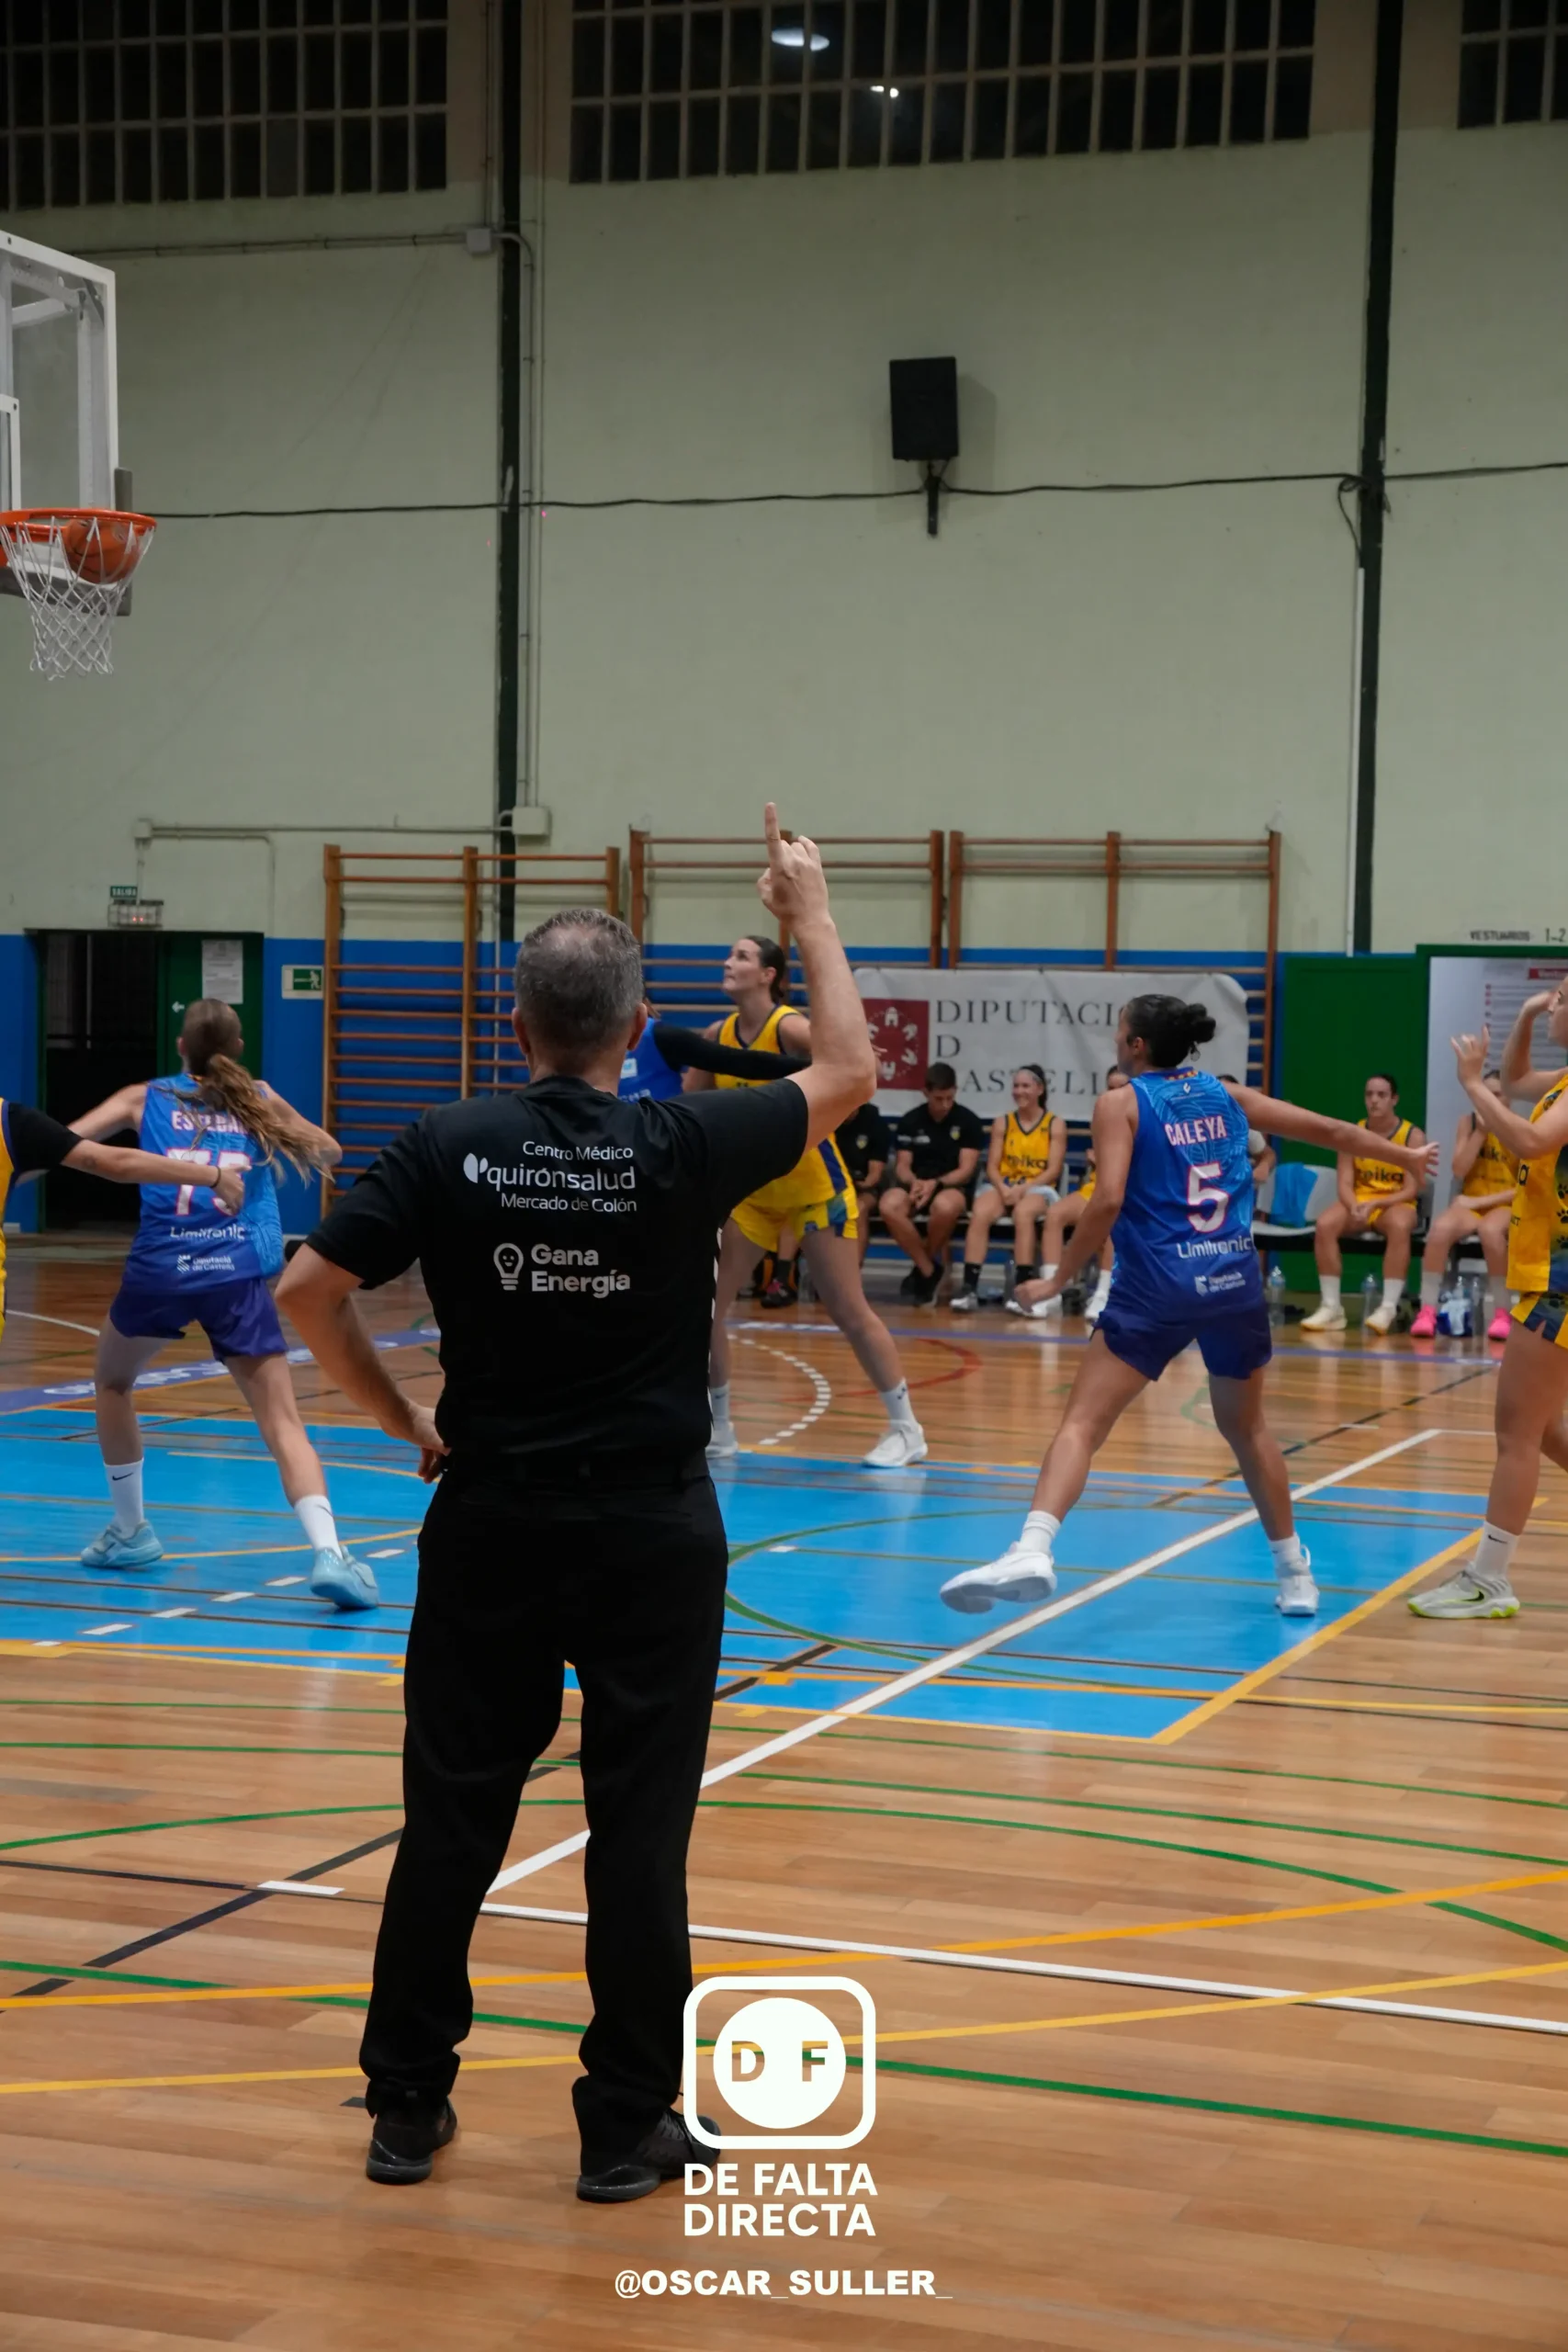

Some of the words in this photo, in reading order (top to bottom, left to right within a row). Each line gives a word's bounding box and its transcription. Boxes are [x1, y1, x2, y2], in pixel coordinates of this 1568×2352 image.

[936, 999, 1122, 1027] DIPUTACI
[1165, 1114, 1226, 1146] CALEYA
[523, 1141, 573, 1160] Centro
[576, 1146, 634, 1160] Médico
[486, 1163, 636, 1192] quirónsalud
[501, 1193, 569, 1210] Mercado
[571, 1197, 589, 1211] de
[592, 1197, 637, 1212] Colón
[1187, 1160, 1230, 1233] 5
[531, 1243, 599, 1266] Gana
[531, 1269, 631, 1298] Energía
